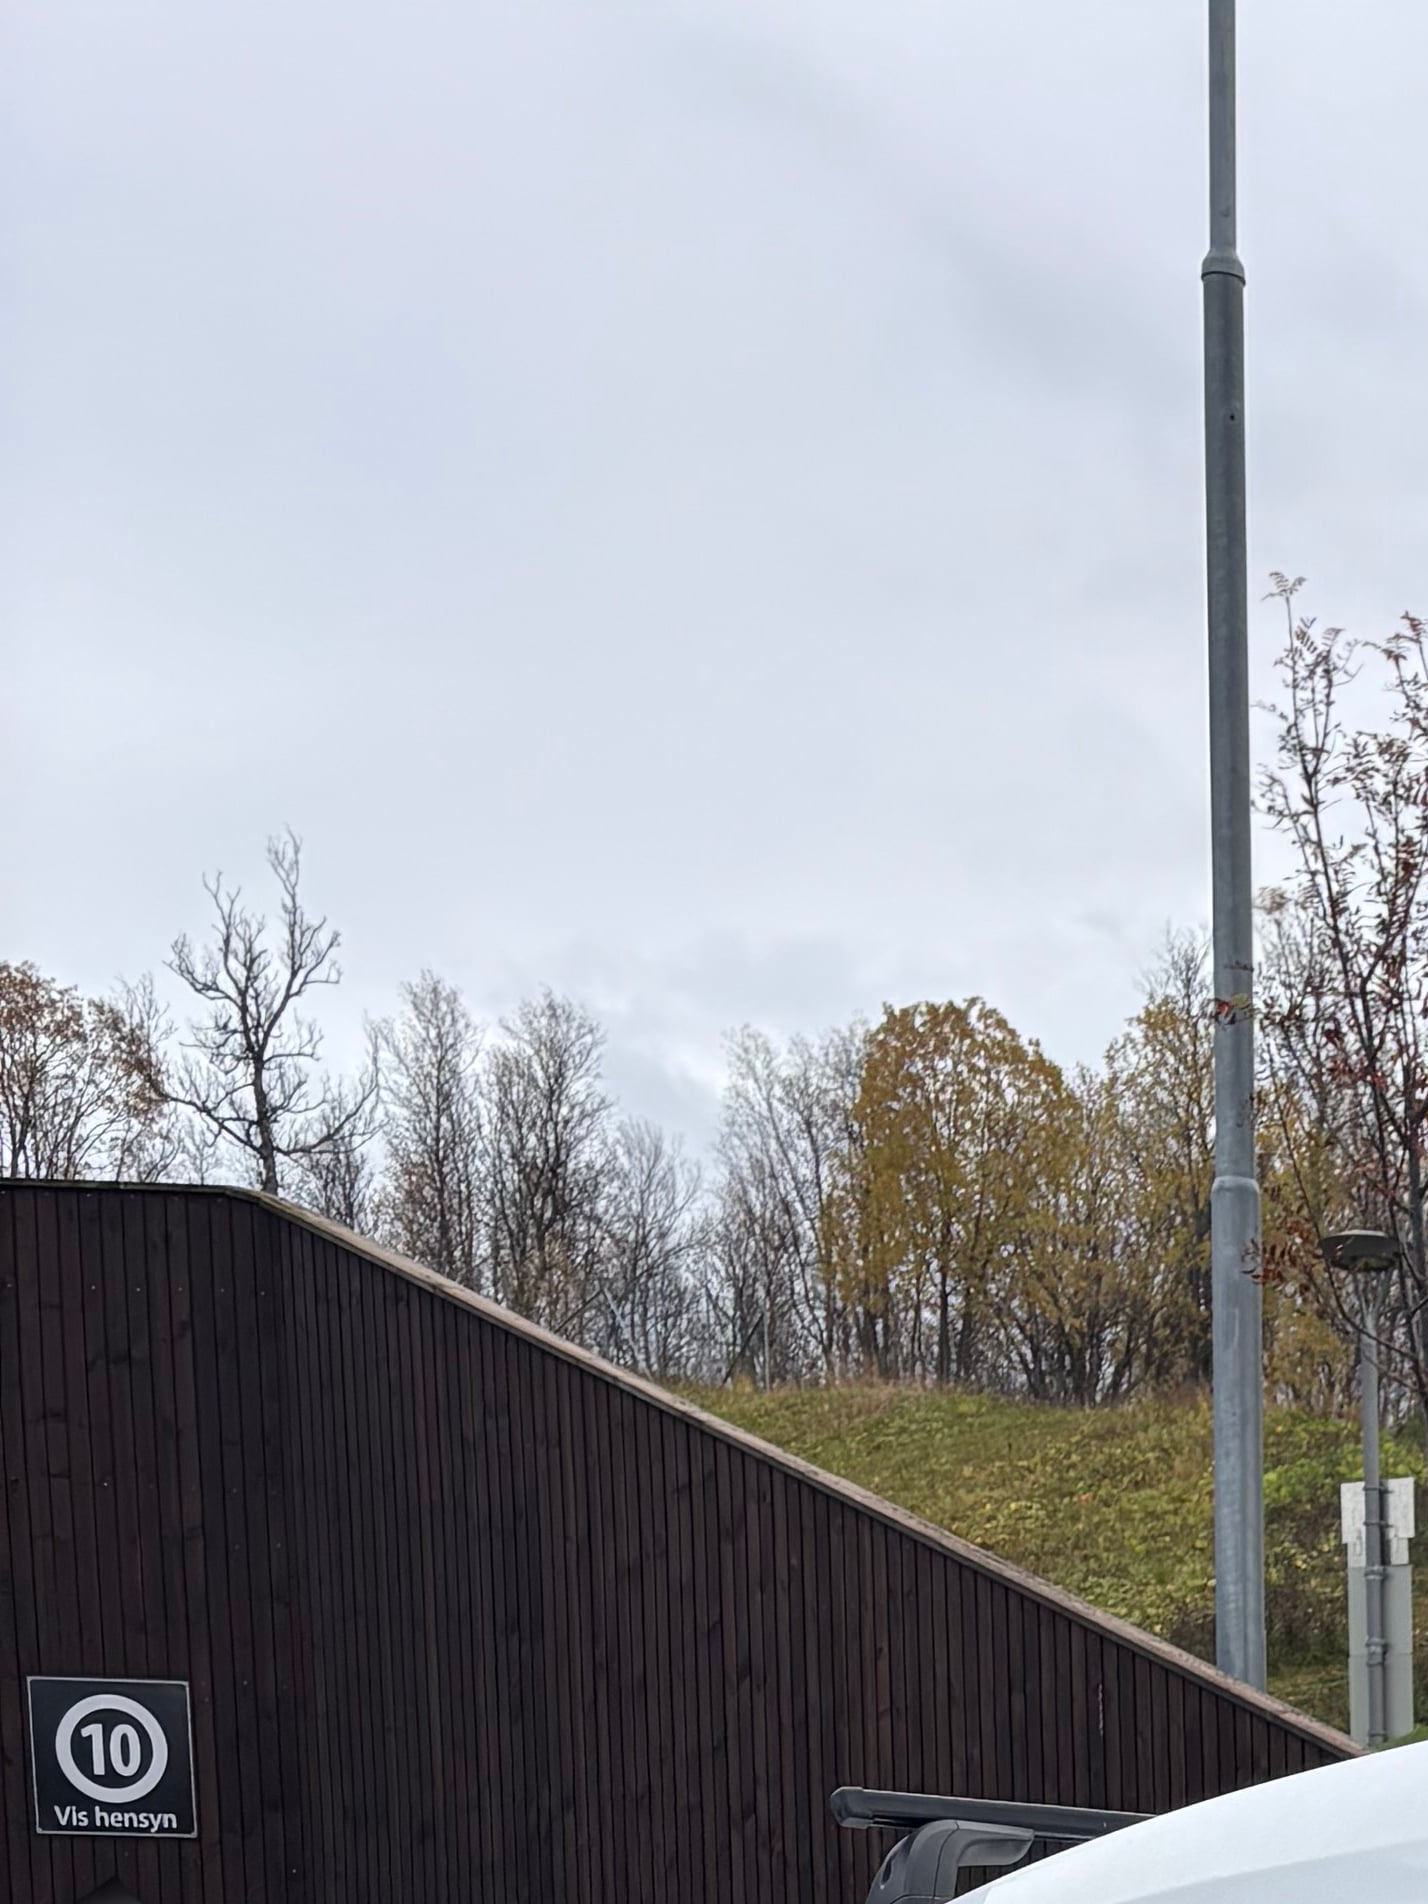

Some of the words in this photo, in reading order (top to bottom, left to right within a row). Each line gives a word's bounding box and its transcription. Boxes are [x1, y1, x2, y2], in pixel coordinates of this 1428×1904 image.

[80, 1723, 141, 1776] 10
[53, 1805, 88, 1827] Vis
[95, 1807, 177, 1833] hensyn
